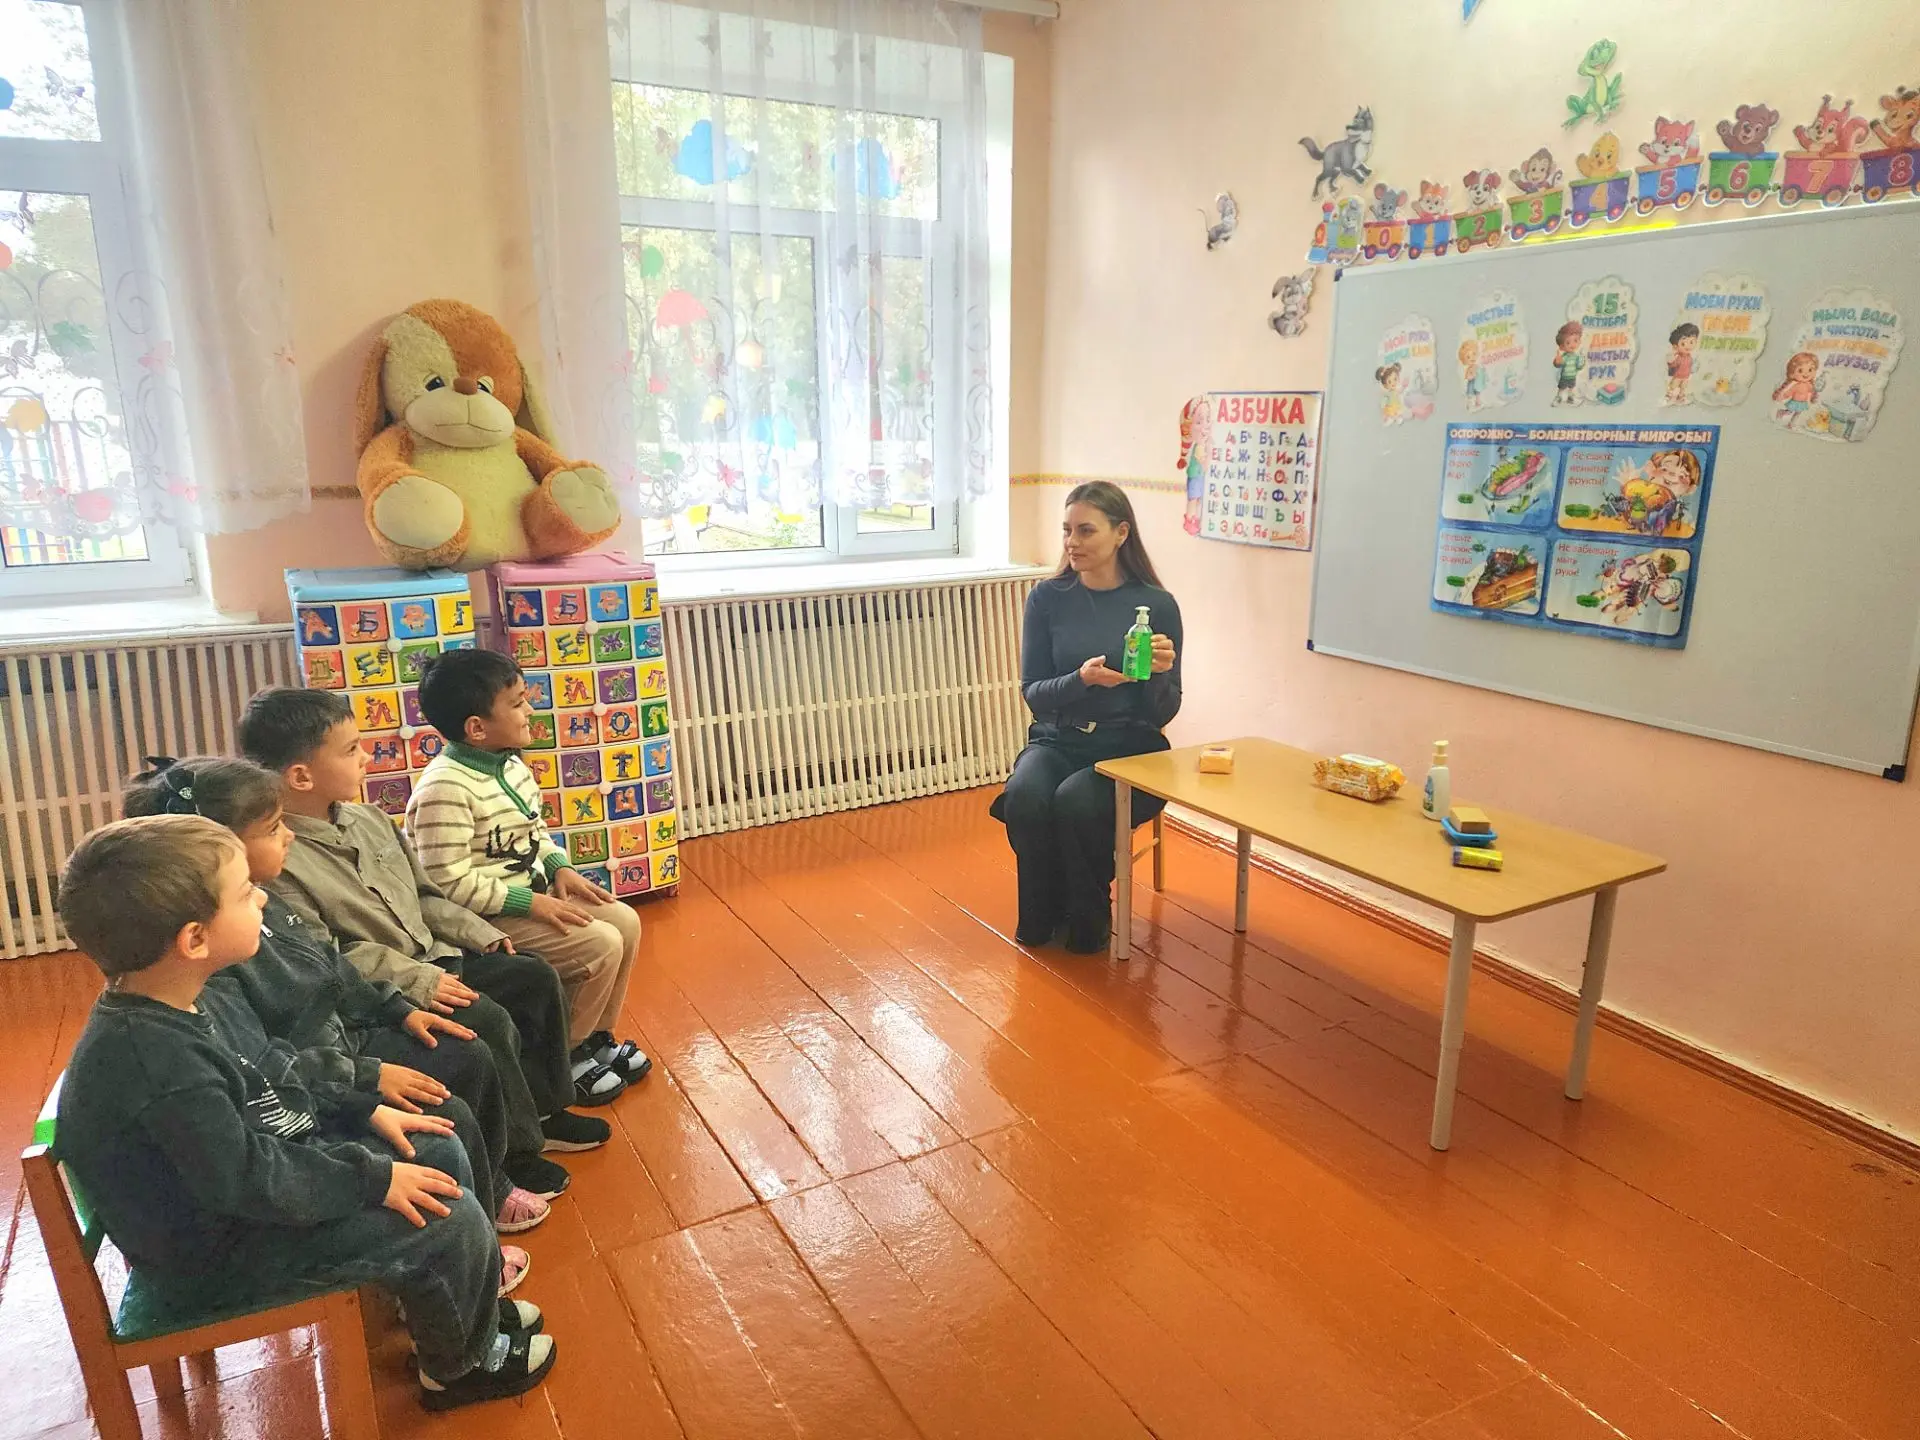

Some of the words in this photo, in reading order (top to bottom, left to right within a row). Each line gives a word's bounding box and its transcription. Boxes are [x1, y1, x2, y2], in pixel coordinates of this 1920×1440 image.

[1379, 230, 1390, 247] 0
[1473, 216, 1486, 236] 2
[1528, 200, 1544, 224] 3
[1589, 183, 1609, 212] 4
[1656, 169, 1676, 199] 5
[1728, 161, 1752, 191] 6
[1807, 160, 1834, 193] 7
[1888, 154, 1915, 186] 8
[1593, 293, 1621, 315] 15
[1727, 295, 1763, 310] РУКИ
[1467, 303, 1515, 326] ЧИСТЫЕ
[1582, 314, 1627, 327] ОКТЯБРЯ
[1812, 308, 1857, 322] МЫЛО,
[1860, 307, 1897, 328] ВОДА
[1589, 332, 1628, 348] ДЕНЬ
[1827, 325, 1880, 339] ЧИСТОТА
[1587, 350, 1631, 361] ЧИСТЫХ
[1824, 353, 1881, 374] ДРУЗЬЯ
[1588, 365, 1616, 379] РУК
[1217, 397, 1305, 425] АЗБУКА
[1240, 430, 1248, 443] Б
[1259, 431, 1267, 444] В
[1278, 432, 1286, 445] Г
[1297, 431, 1307, 447] Д
[1450, 428, 1514, 439] ОСТОРОЖНО
[1528, 429, 1637, 442] БОЛЕЗНЕТВОРНЫЕ
[1638, 430, 1712, 443] МИКРОБЫ!
[1238, 449, 1248, 462] Ж
[1259, 451, 1265, 464] З
[1276, 451, 1286, 464] И
[1296, 451, 1305, 466] Й
[1210, 465, 1217, 476] К
[1223, 468, 1231, 479] Л
[1238, 468, 1246, 480] М
[1256, 468, 1265, 481] Н
[1274, 470, 1286, 483] О
[1295, 471, 1304, 484] П
[1209, 484, 1216, 496] Р
[1222, 485, 1230, 497] С
[1238, 486, 1244, 498] Т
[1256, 488, 1264, 500] У
[1272, 489, 1284, 501] Ф
[1292, 490, 1302, 504] Х
[1236, 504, 1245, 517] Ш
[1275, 509, 1285, 522] Ъ
[1293, 511, 1305, 524] Ы
[1208, 519, 1215, 531] Ь
[1220, 520, 1228, 532] Э
[1233, 522, 1243, 535] Ю
[1253, 525, 1261, 537] Я
[511, 592, 538, 623] А
[560, 592, 579, 616] Б
[358, 608, 379, 634] Б
[555, 632, 579, 657] Е
[569, 717, 591, 738] Н
[610, 711, 631, 733] О
[374, 741, 398, 764] Н
[420, 734, 442, 756] О
[530, 759, 550, 784] Р
[573, 756, 593, 777] С
[612, 751, 634, 777] Т
[381, 781, 404, 804] С
[573, 793, 596, 821] Х
[620, 866, 644, 885] Ю
[663, 855, 677, 879] Я
